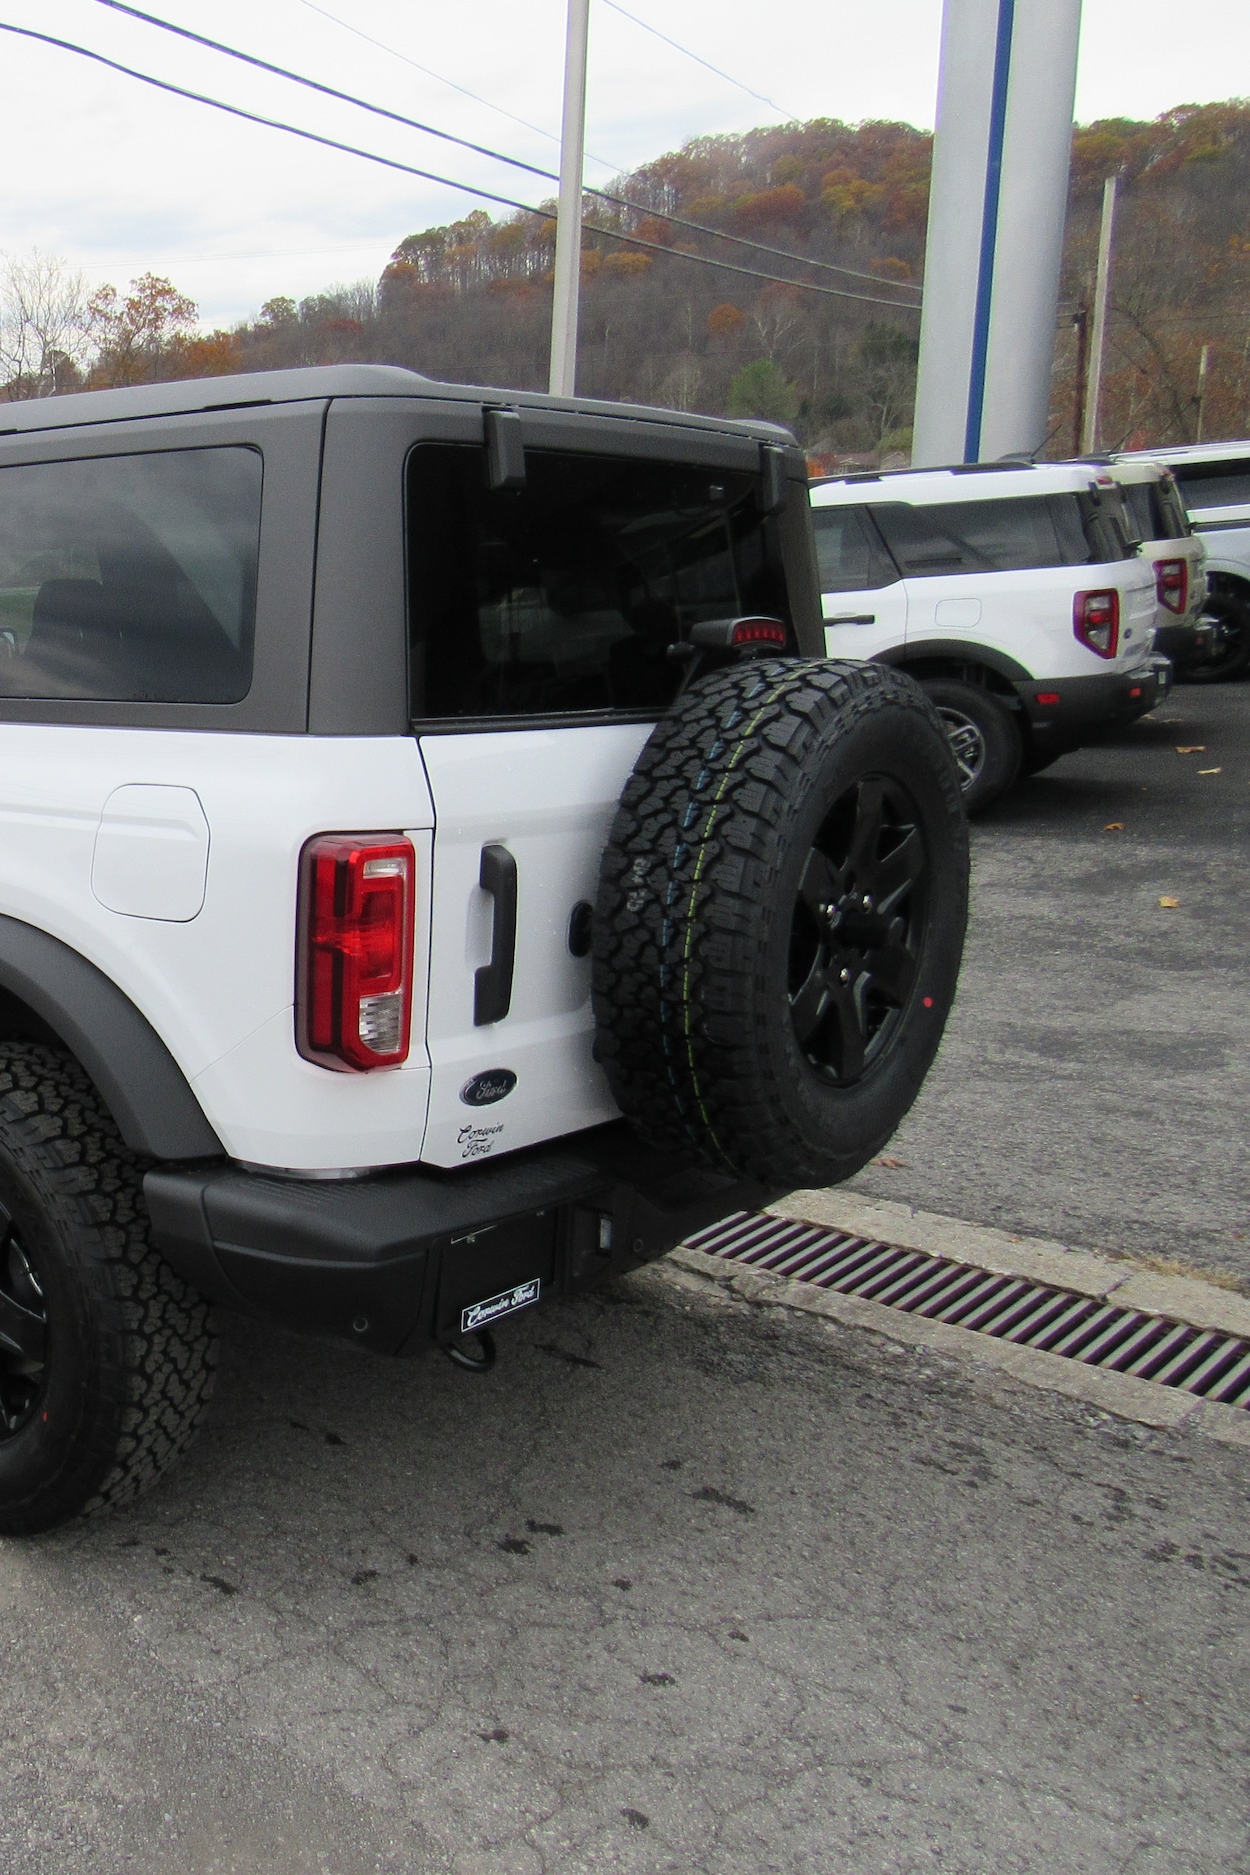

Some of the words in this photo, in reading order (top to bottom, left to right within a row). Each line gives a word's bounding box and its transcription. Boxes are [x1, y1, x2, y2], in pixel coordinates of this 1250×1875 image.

[475, 1079, 507, 1100] Ford
[457, 1122, 504, 1143] Corwin
[462, 1138, 495, 1157] Ford
[467, 1299, 510, 1326] Corwin
[511, 1285, 535, 1306] Ford
